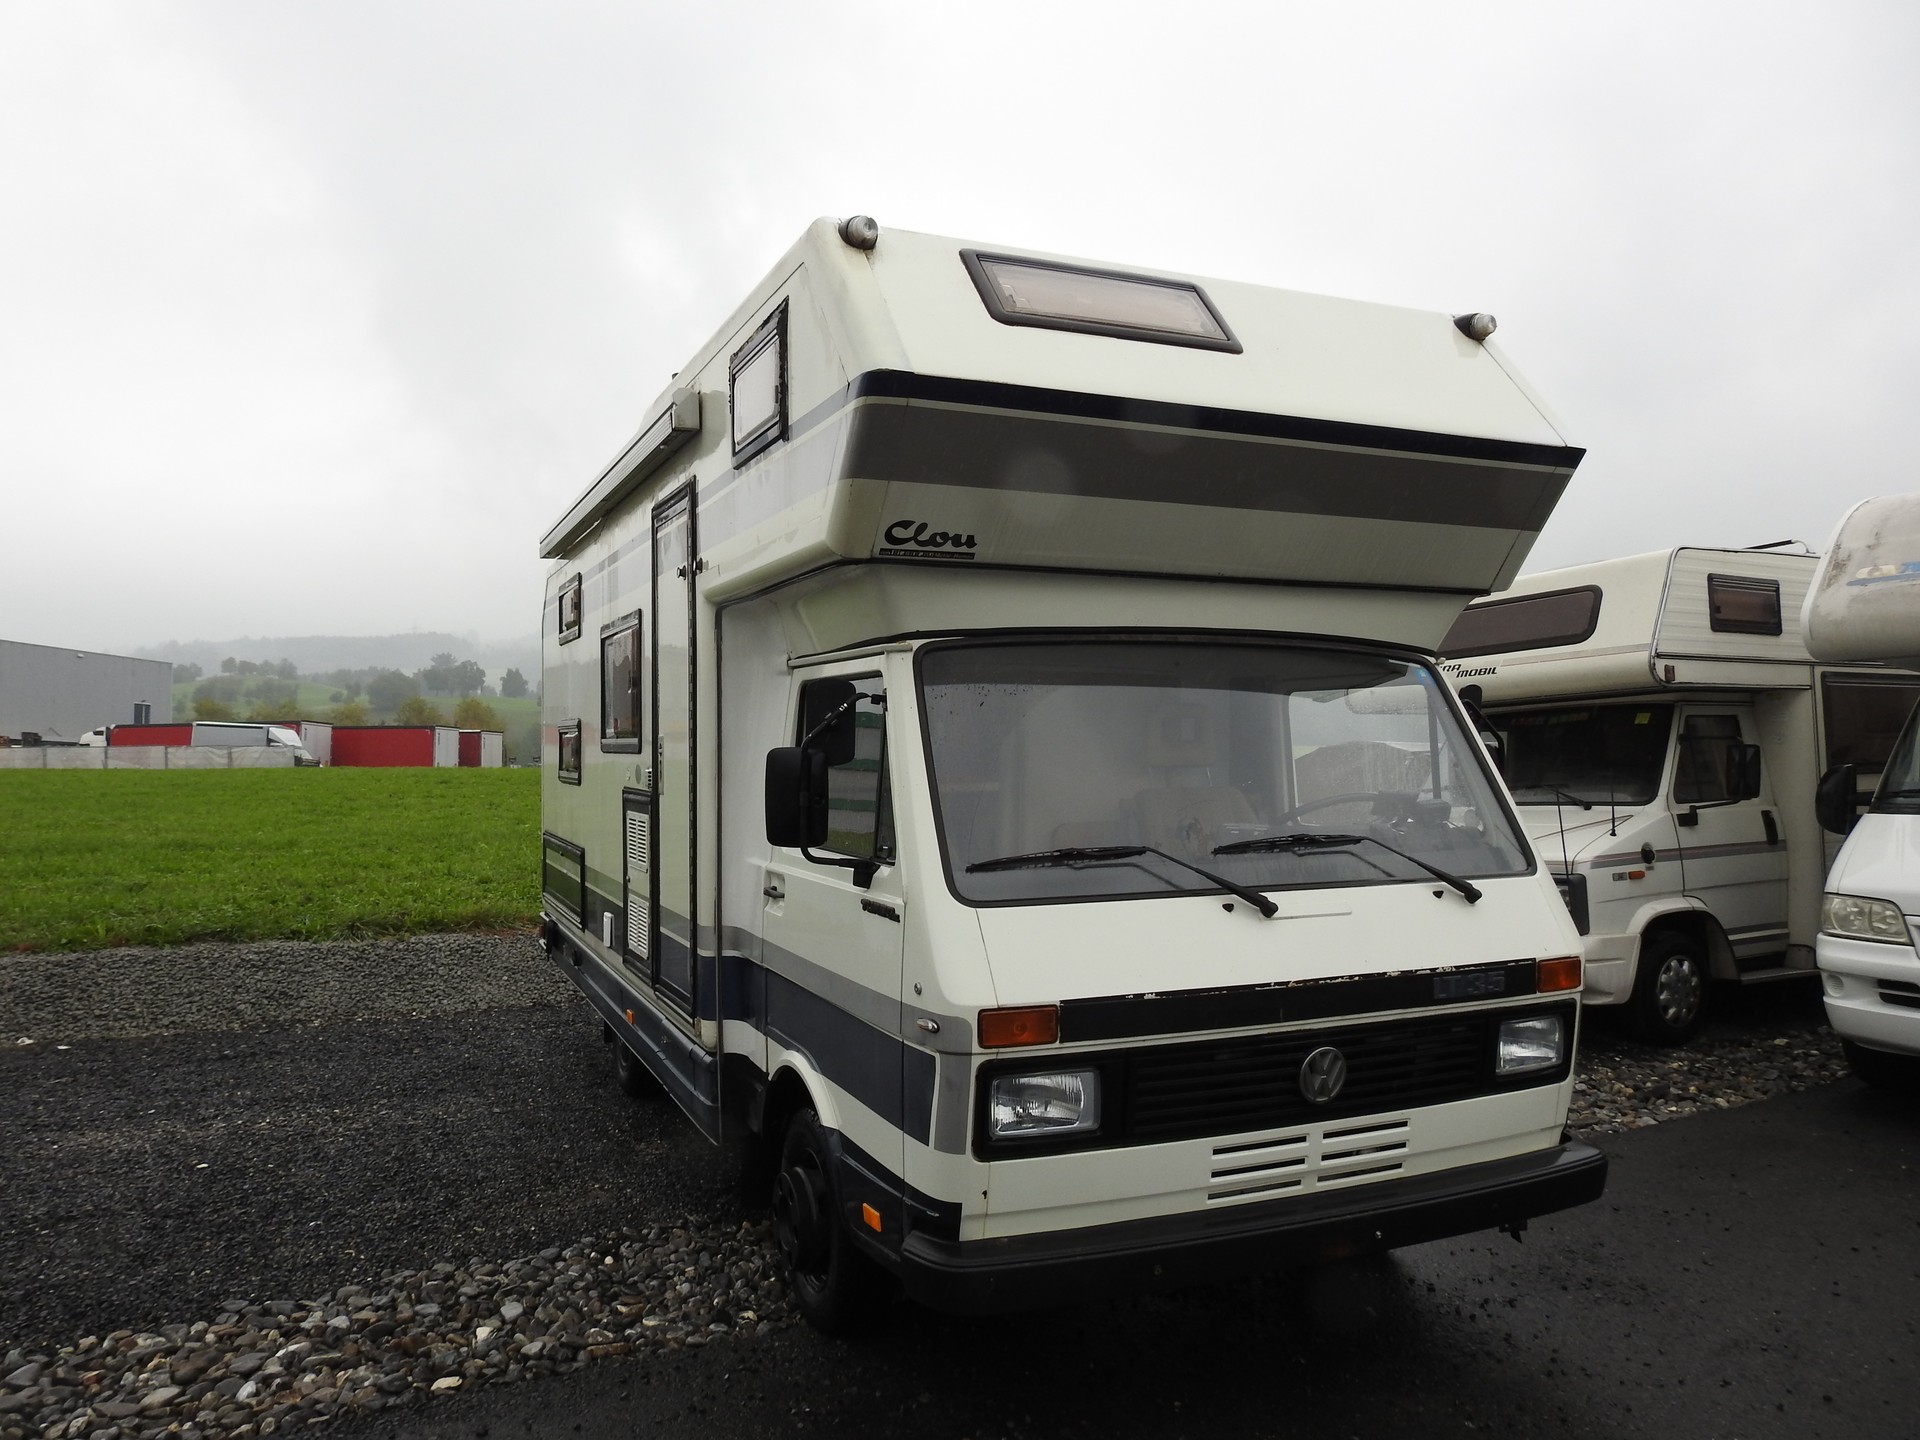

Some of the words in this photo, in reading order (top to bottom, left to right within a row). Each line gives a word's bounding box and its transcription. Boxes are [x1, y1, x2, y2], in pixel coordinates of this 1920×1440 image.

[884, 519, 978, 549] Clou
[1440, 664, 1462, 672] RA
[1456, 667, 1498, 678] MOBIL
